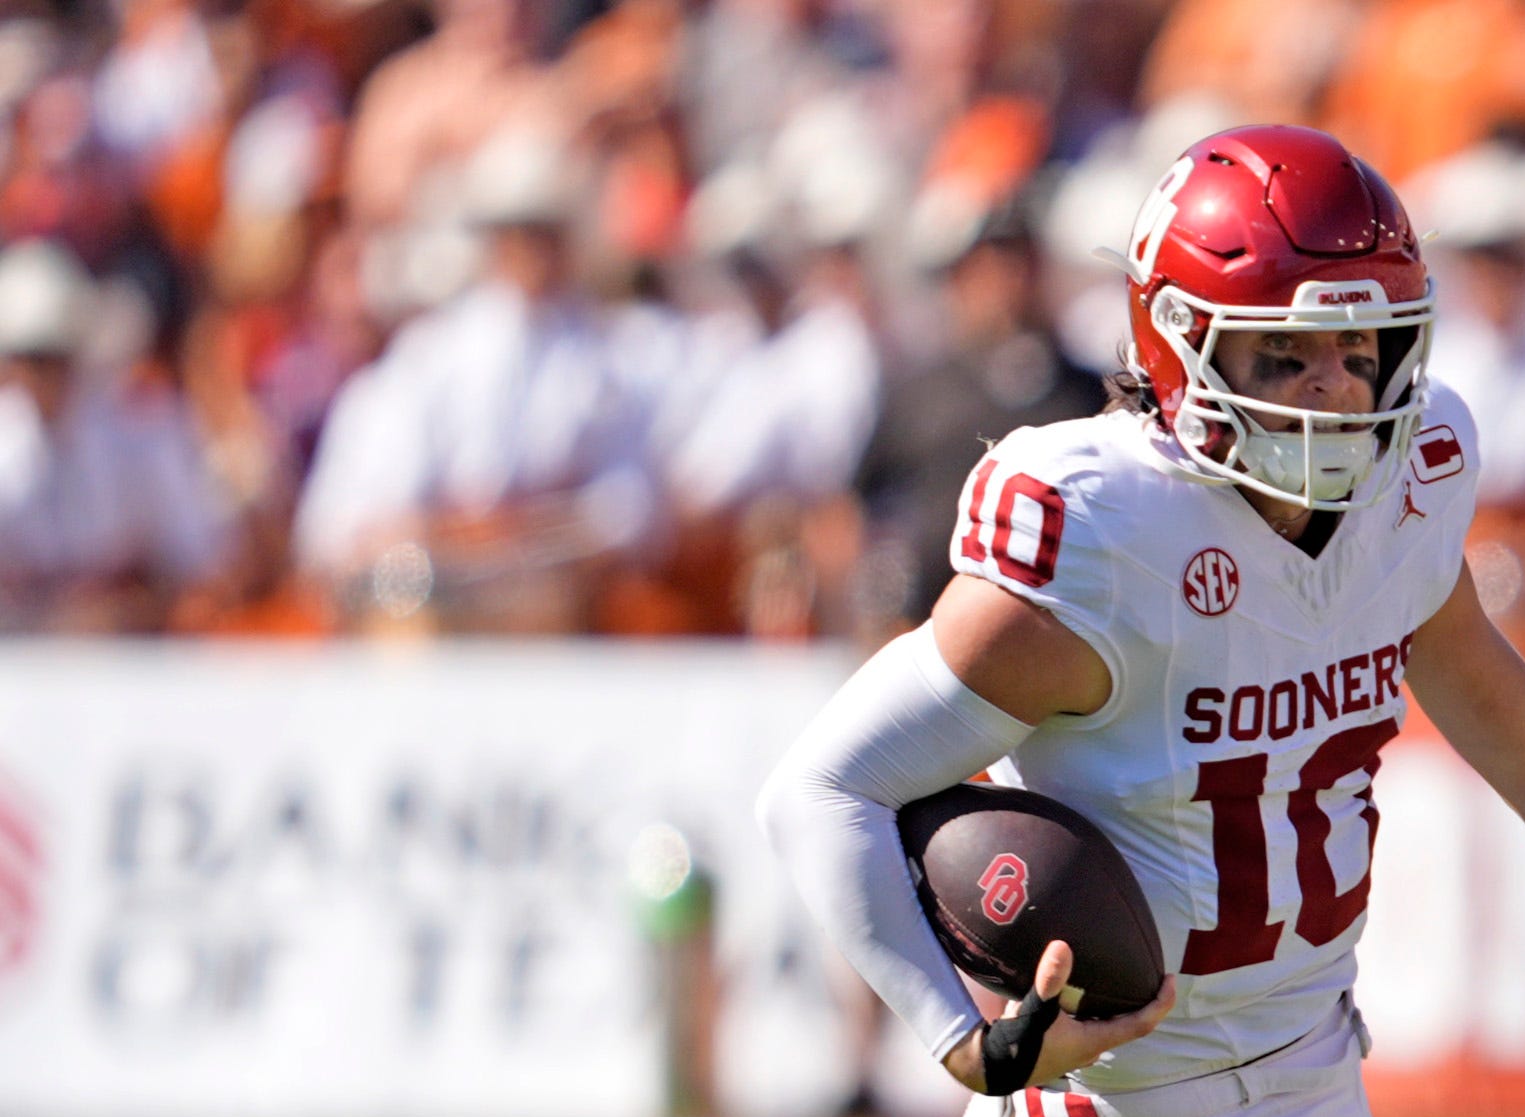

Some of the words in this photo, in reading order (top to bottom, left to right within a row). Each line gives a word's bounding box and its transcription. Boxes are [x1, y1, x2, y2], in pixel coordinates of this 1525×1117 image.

[961, 458, 1066, 588] 10
[1184, 549, 1239, 616] SEC
[1179, 716, 1400, 976] 10
